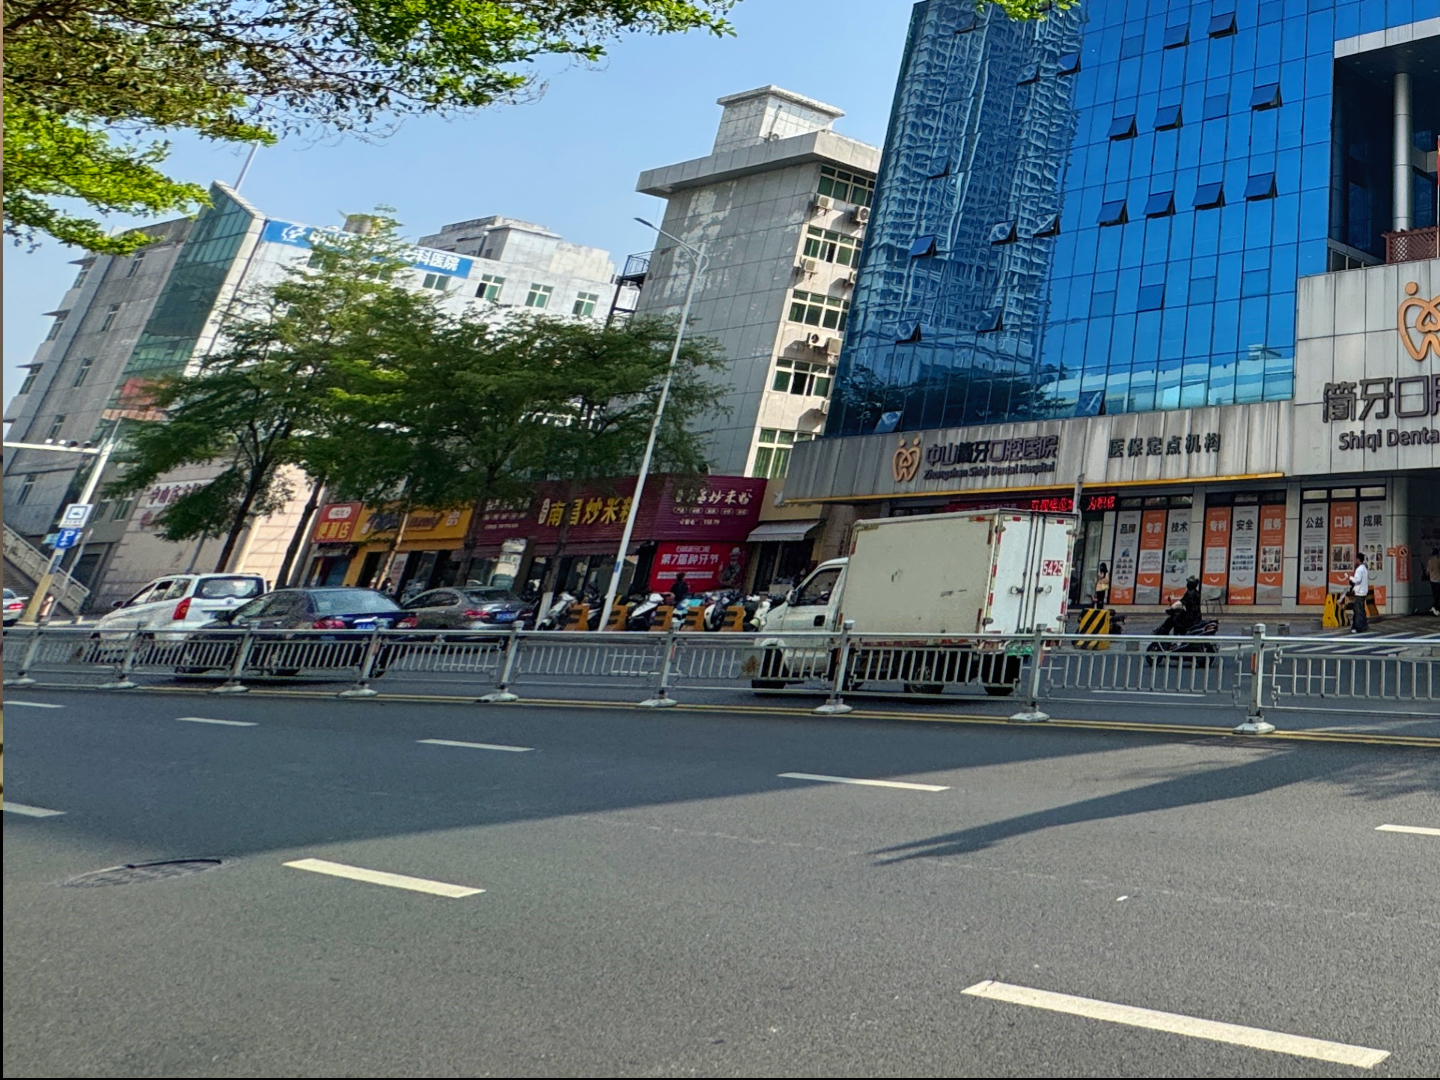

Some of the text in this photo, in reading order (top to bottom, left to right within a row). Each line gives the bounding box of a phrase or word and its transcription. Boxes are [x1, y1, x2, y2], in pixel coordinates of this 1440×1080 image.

[1108, 433, 1221, 459] 医保定点机构
[1338, 428, 1383, 453] Shiqi
[923, 462, 1056, 481] Zhongshan Shiqi Dental Hospital
[1171, 521, 1188, 533] 技术
[1209, 520, 1227, 532] 专利
[1236, 519, 1254, 531] 安全
[1264, 518, 1282, 531] 服务
[1306, 516, 1324, 528] 公益
[1334, 515, 1353, 528] 口碑
[1363, 514, 1383, 527] 成果
[1120, 523, 1136, 535] 品牌
[1145, 522, 1163, 534] 专家
[1042, 560, 1064, 576] 5425
